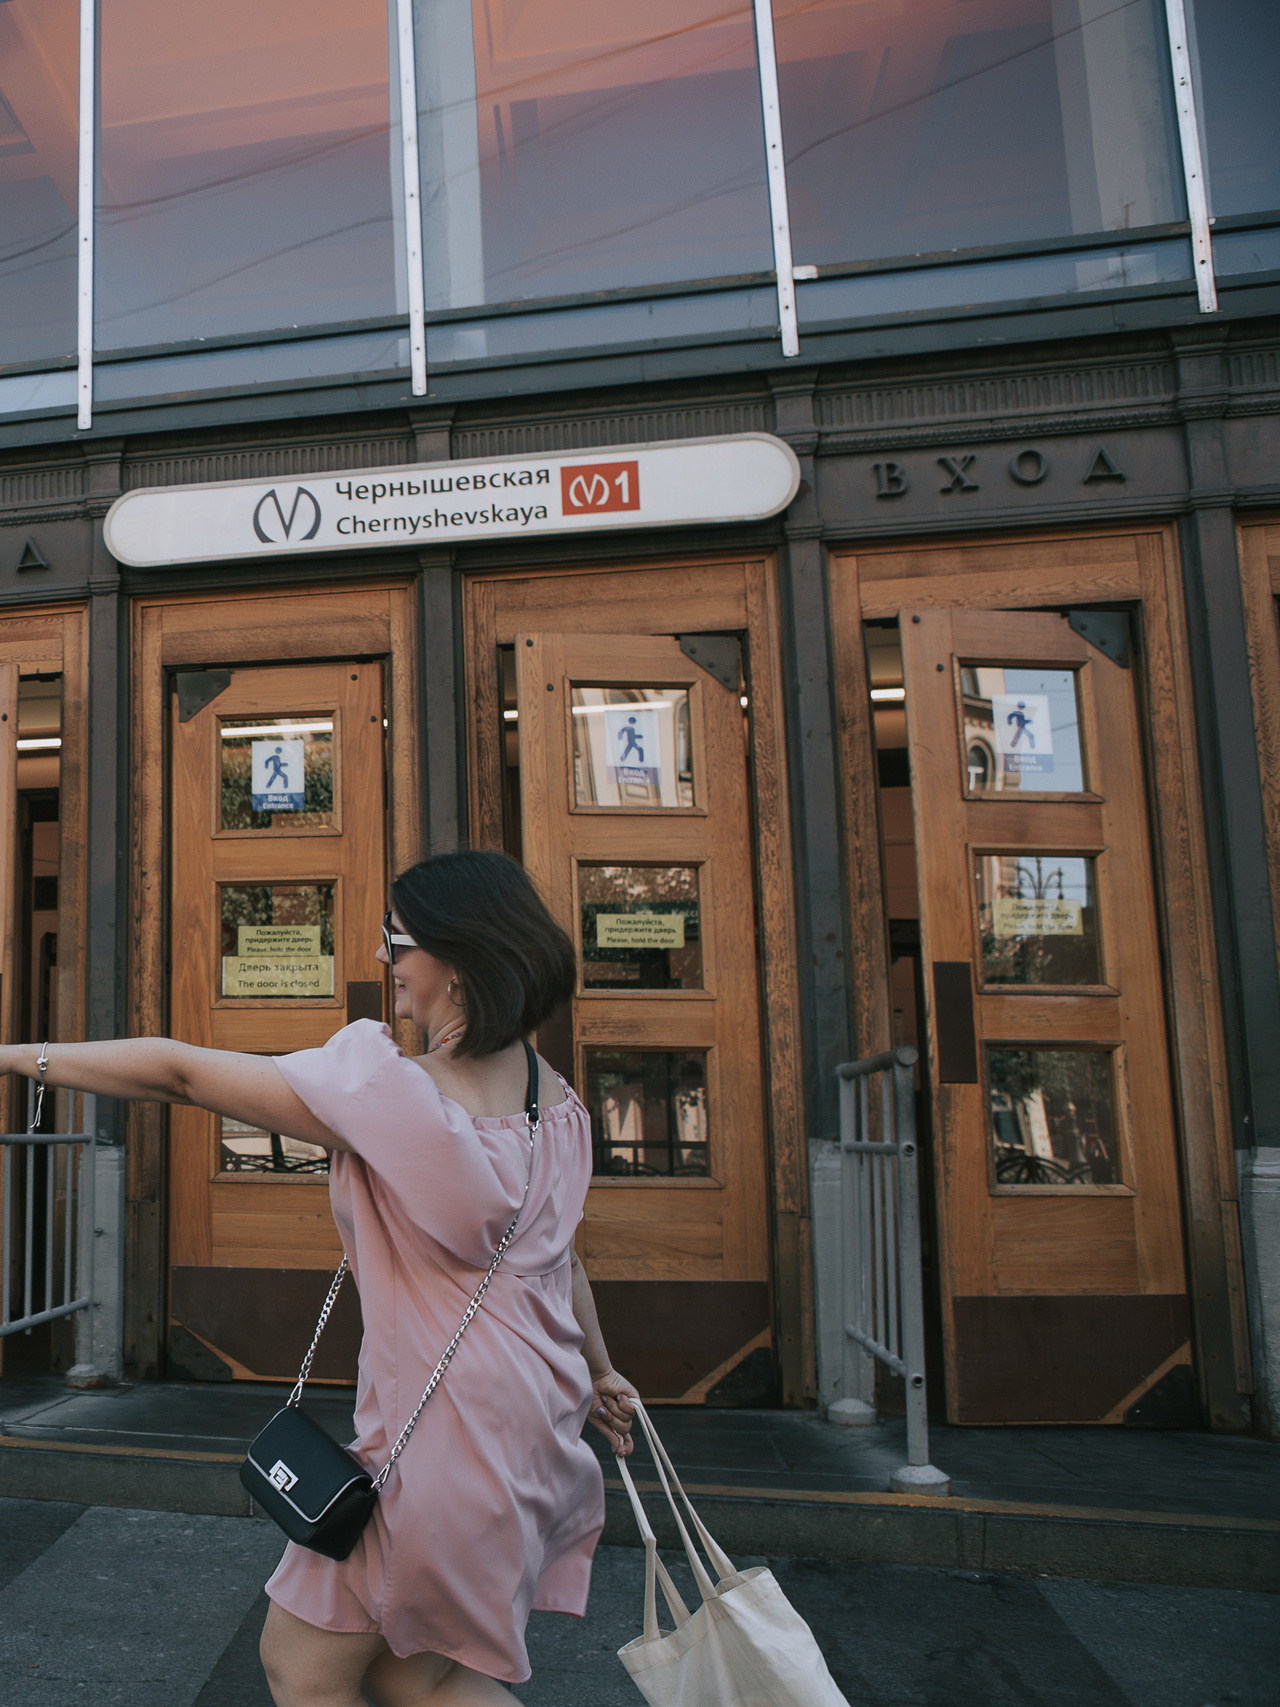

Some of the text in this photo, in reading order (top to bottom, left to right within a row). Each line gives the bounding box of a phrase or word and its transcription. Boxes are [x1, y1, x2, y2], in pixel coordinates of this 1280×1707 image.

[874, 446, 1126, 498] ВХОД
[336, 469, 550, 503] Чернышевская
[336, 504, 548, 535] Chernyshevskaya
[267, 794, 289, 802] Вход
[262, 802, 294, 810] Entrance
[616, 918, 664, 926] Пожалуйста,
[256, 929, 302, 937] Пожалуйста,
[238, 963, 319, 973] Дверь закрыта
[238, 979, 320, 988] The door is closed
